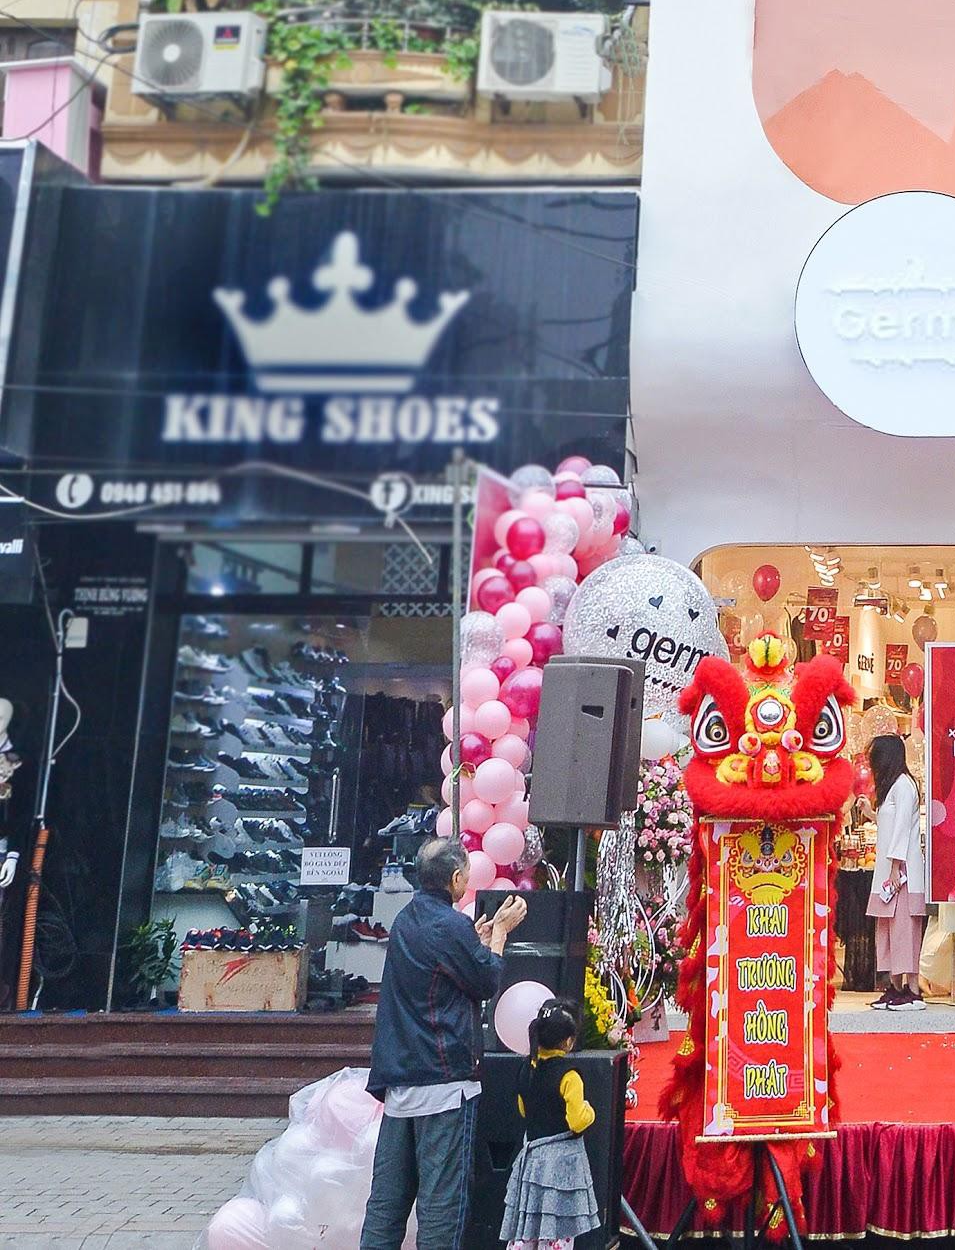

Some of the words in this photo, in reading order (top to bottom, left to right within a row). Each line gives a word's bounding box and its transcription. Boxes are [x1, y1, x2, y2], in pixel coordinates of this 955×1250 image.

[162, 395, 305, 443] KING
[322, 396, 500, 443] SHOES
[747, 905, 787, 936] KHAI
[744, 1060, 788, 1099] PHÁT
